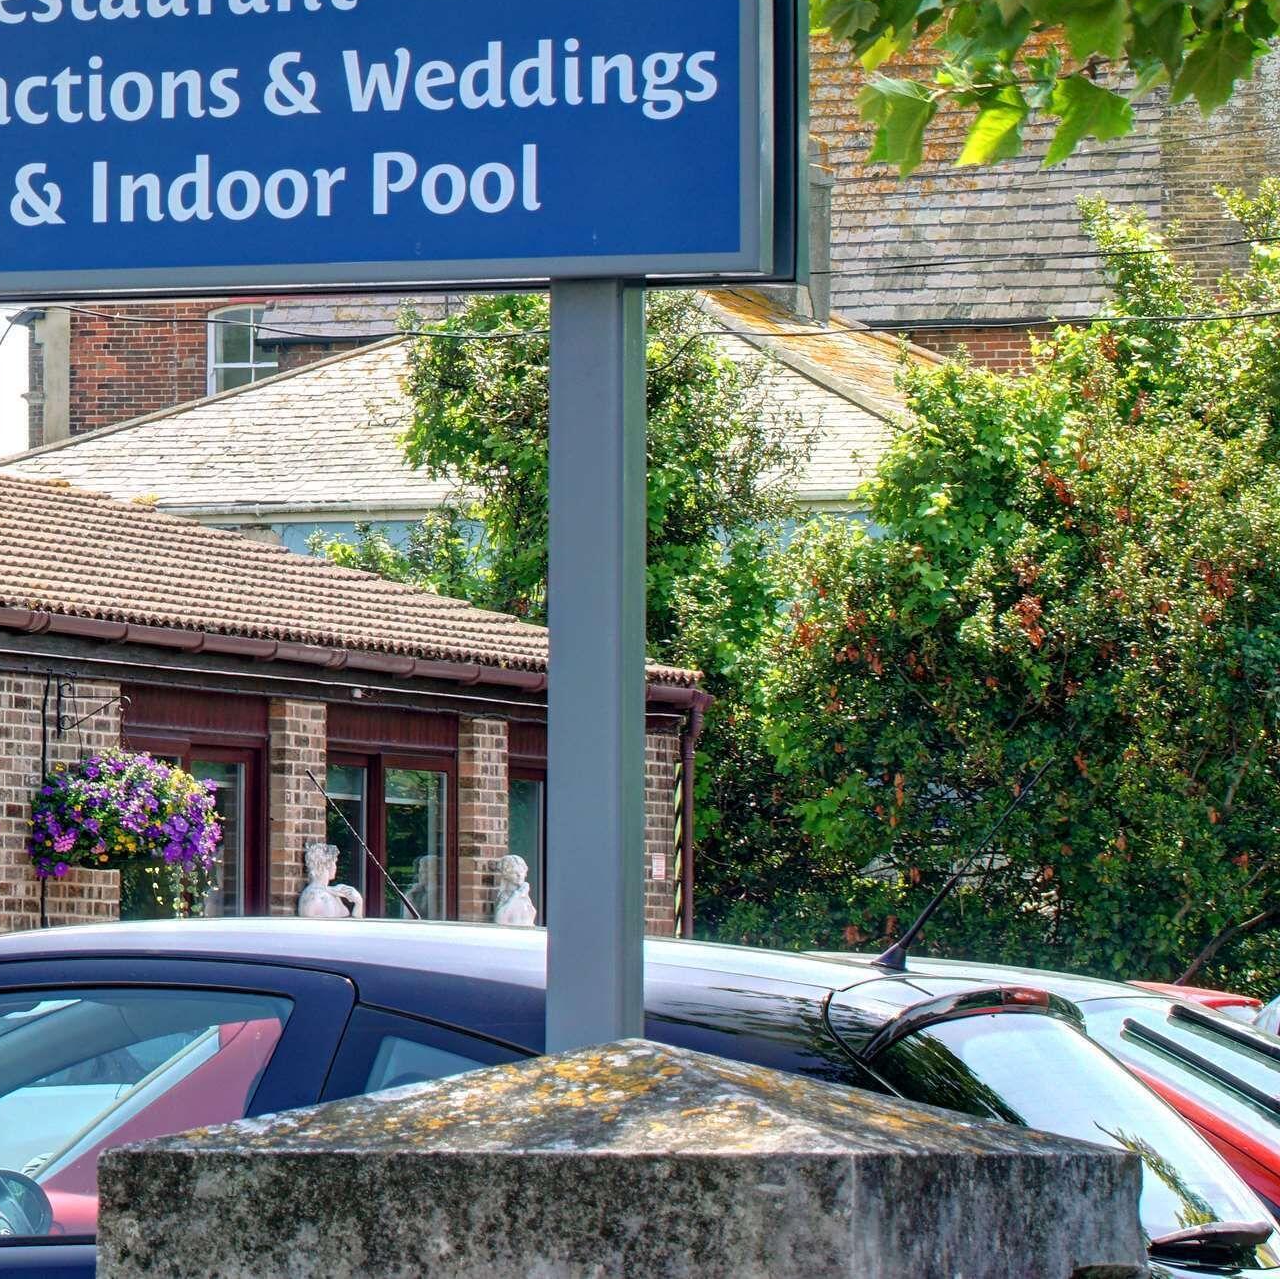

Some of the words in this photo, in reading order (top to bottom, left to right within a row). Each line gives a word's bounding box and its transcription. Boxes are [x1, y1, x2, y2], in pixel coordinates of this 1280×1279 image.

[263, 50, 321, 117] &
[342, 37, 718, 120] Weddings
[9, 162, 66, 226] &
[93, 154, 347, 224] Indoor
[373, 144, 541, 215] Pool
